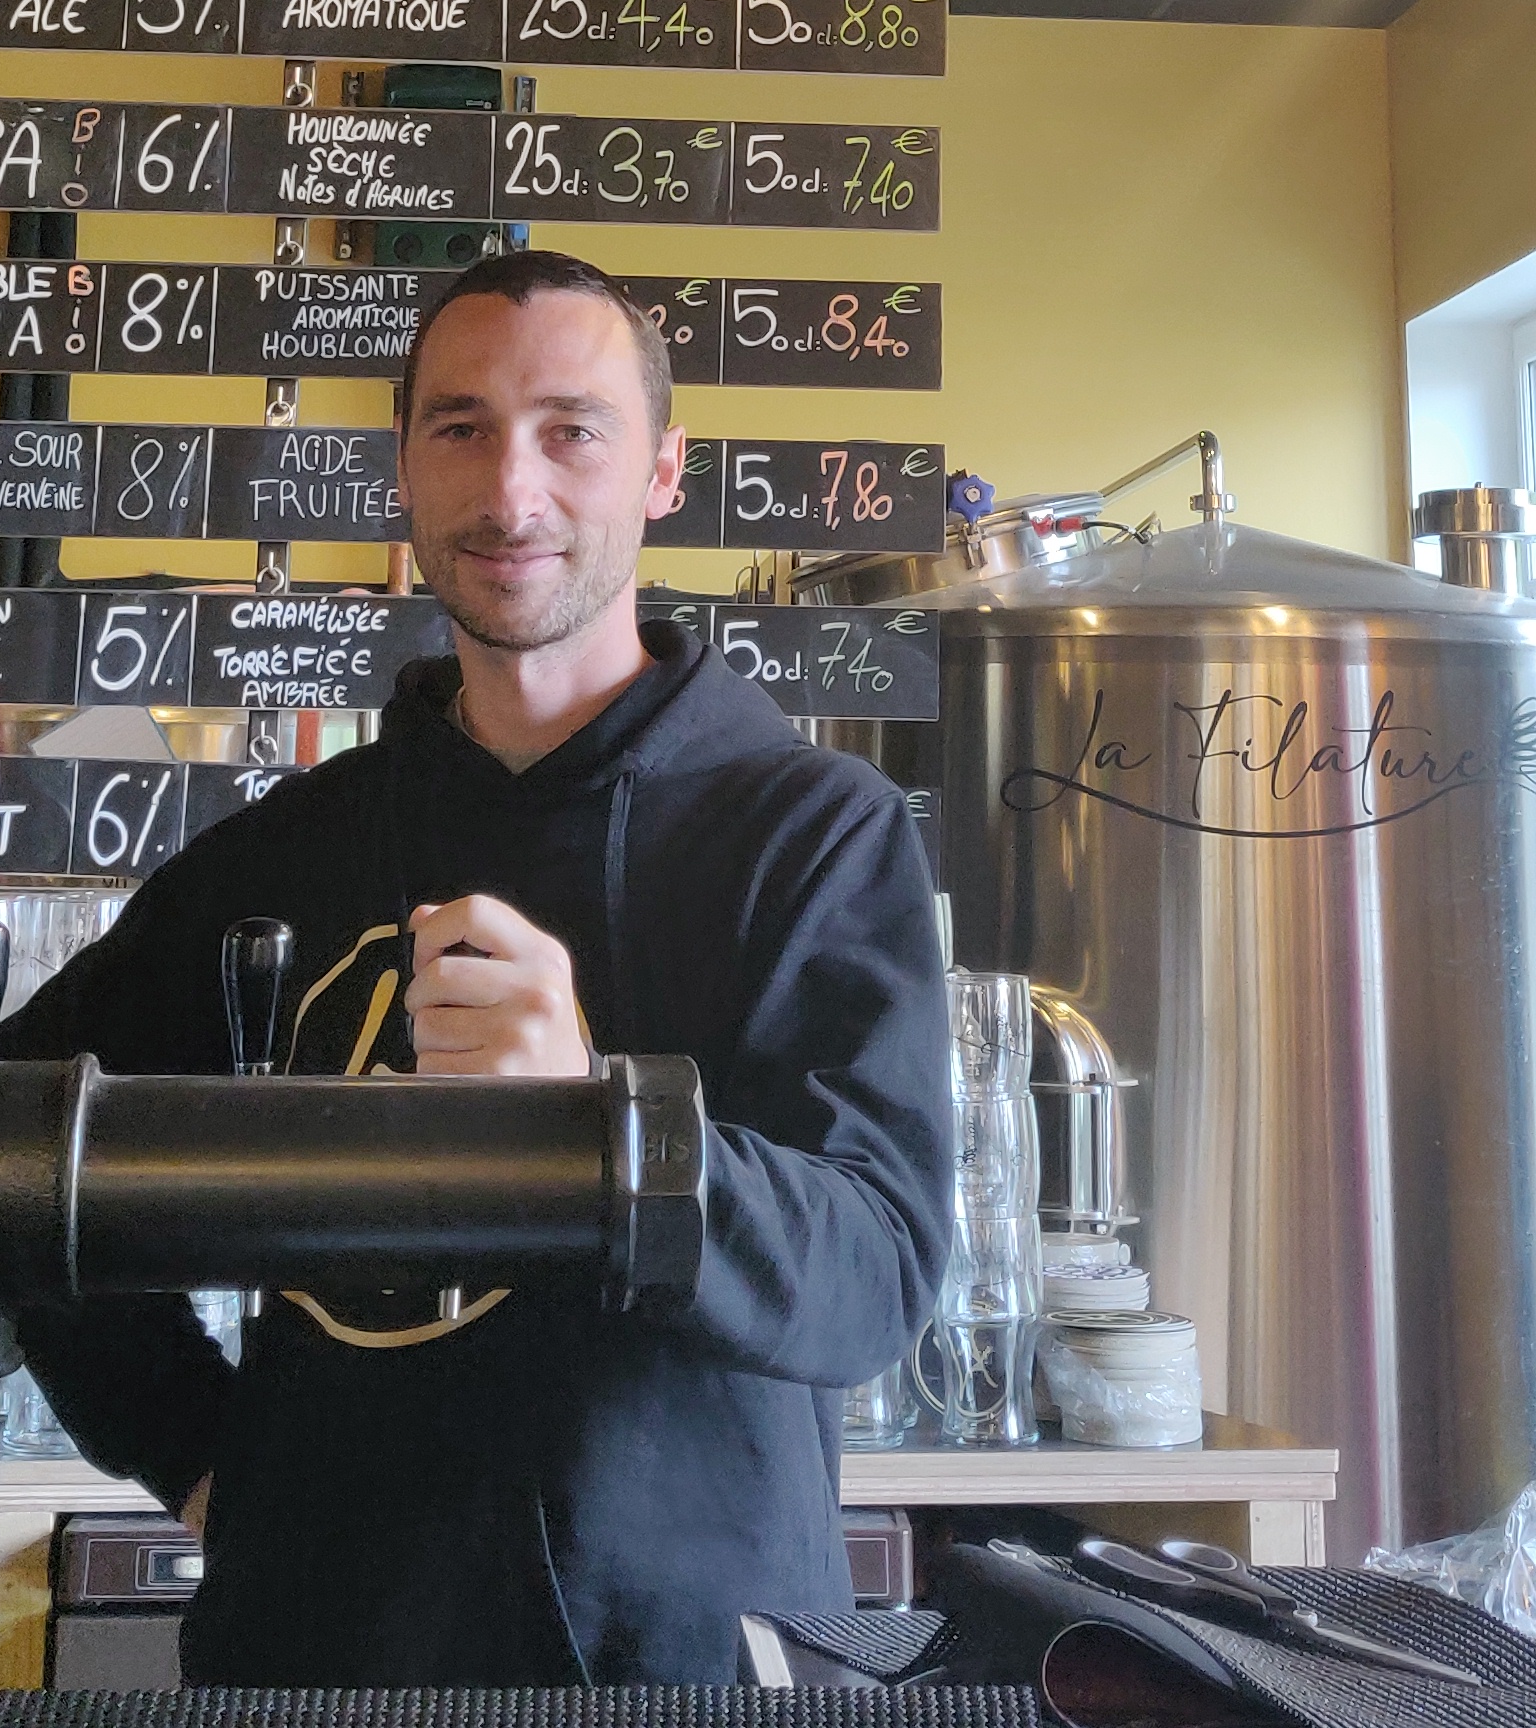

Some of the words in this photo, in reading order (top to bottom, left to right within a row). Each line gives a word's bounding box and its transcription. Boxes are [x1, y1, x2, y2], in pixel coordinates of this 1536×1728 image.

[306, 141, 396, 181] SÈCHE
[121, 272, 205, 353] 8%
[8, 430, 83, 471] SOUR
[117, 435, 201, 521] 8%
[90, 605, 187, 691] 5%
[88, 770, 171, 867] 6%
